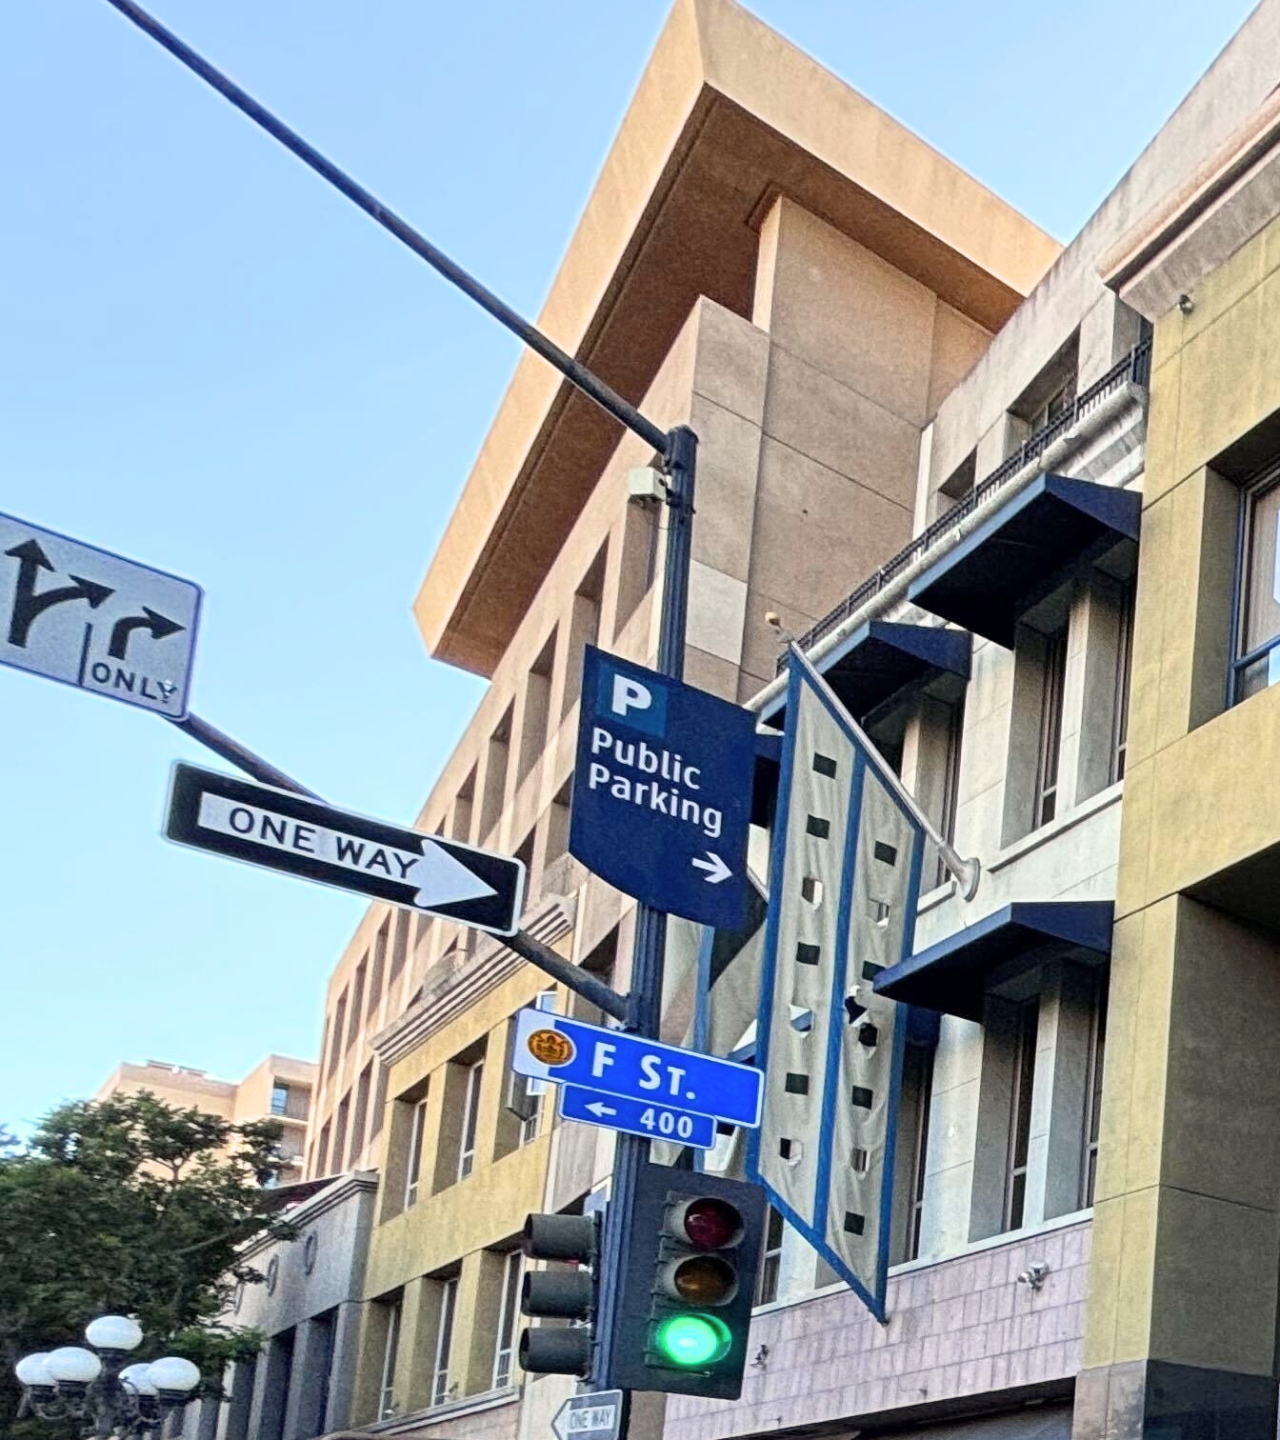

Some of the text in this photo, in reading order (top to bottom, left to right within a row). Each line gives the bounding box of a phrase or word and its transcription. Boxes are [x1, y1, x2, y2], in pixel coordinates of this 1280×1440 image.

[91, 662, 178, 703] ONLY
[611, 674, 652, 716] P
[590, 727, 701, 790] Public
[588, 762, 723, 839] Parking
[228, 807, 420, 880] ONE WAY
[592, 1041, 697, 1101] F ST.
[639, 1108, 694, 1139] 400
[570, 1410, 590, 1429] ONE
